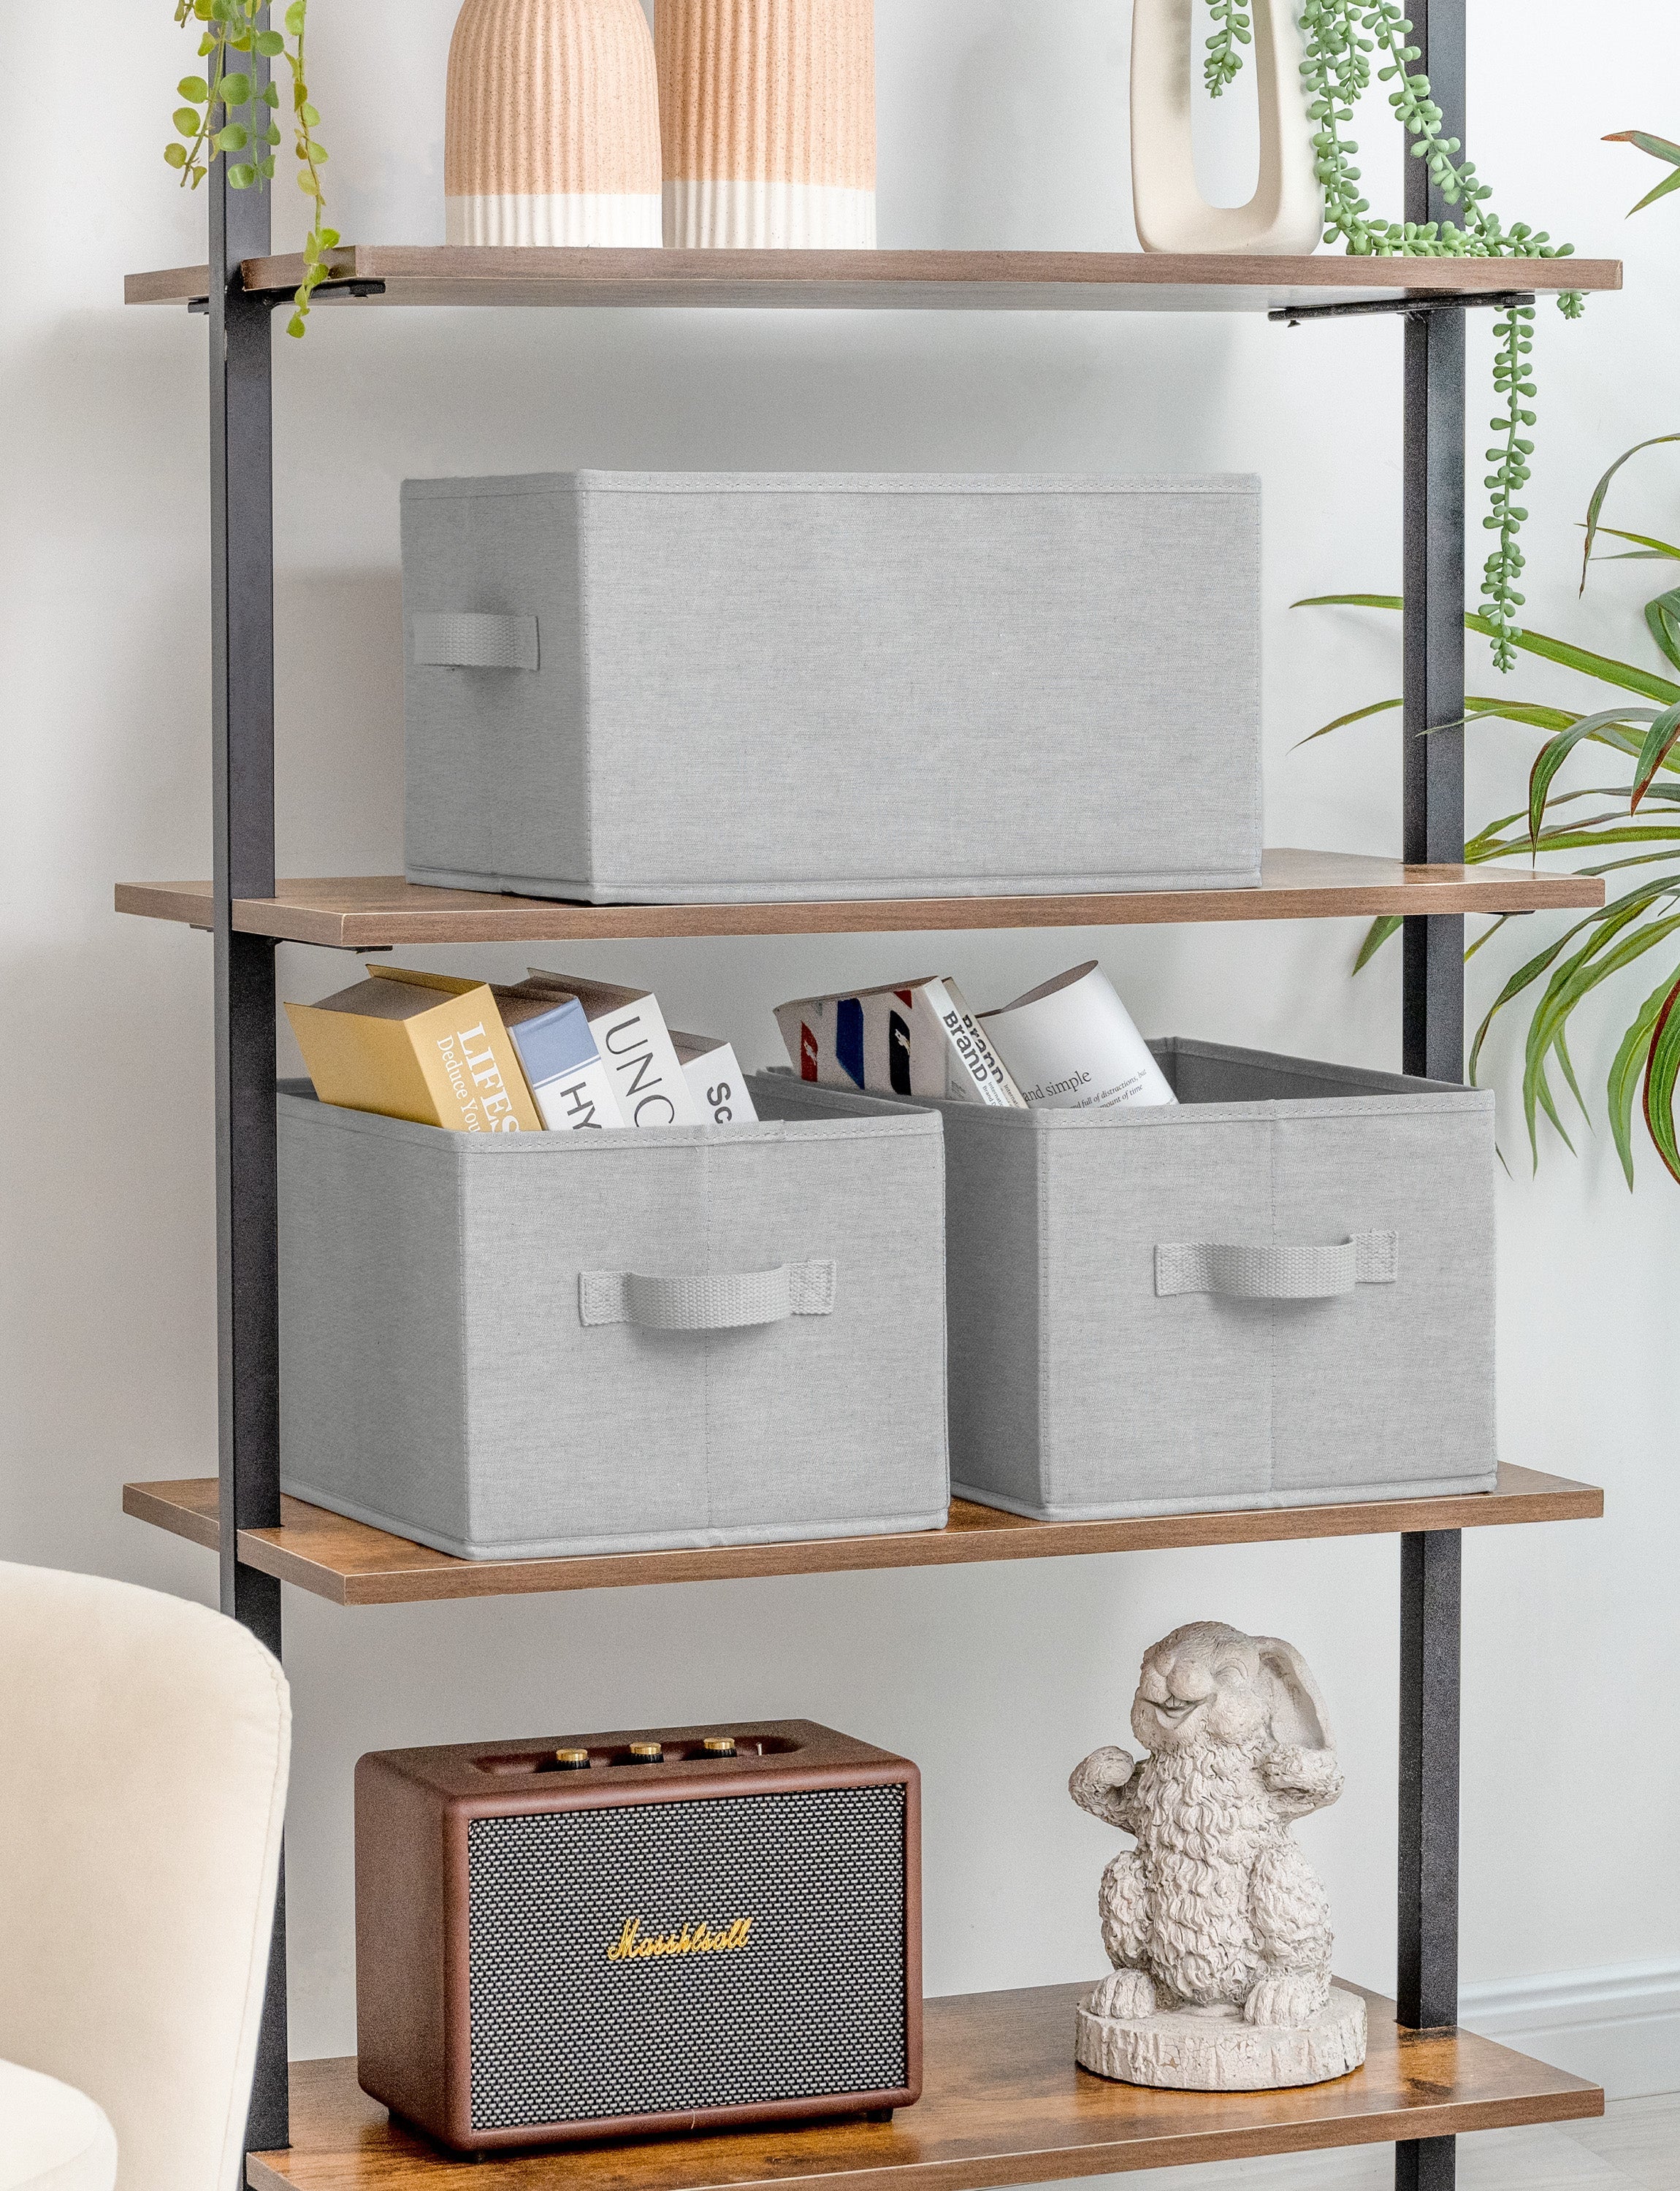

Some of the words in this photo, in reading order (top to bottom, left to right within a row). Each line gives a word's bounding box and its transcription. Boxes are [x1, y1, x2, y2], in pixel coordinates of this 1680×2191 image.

[437, 1034, 468, 1100] Deduce
[1023, 1084, 1045, 1102] and
[1046, 1070, 1092, 1097] simple
[1081, 1097, 1093, 1108] full
[1093, 1093, 1101, 1103] of
[1101, 1075, 1139, 1099] distractions,
[1137, 1068, 1148, 1079] but
[1122, 1090, 1129, 1100] of
[1129, 1084, 1142, 1096] time
